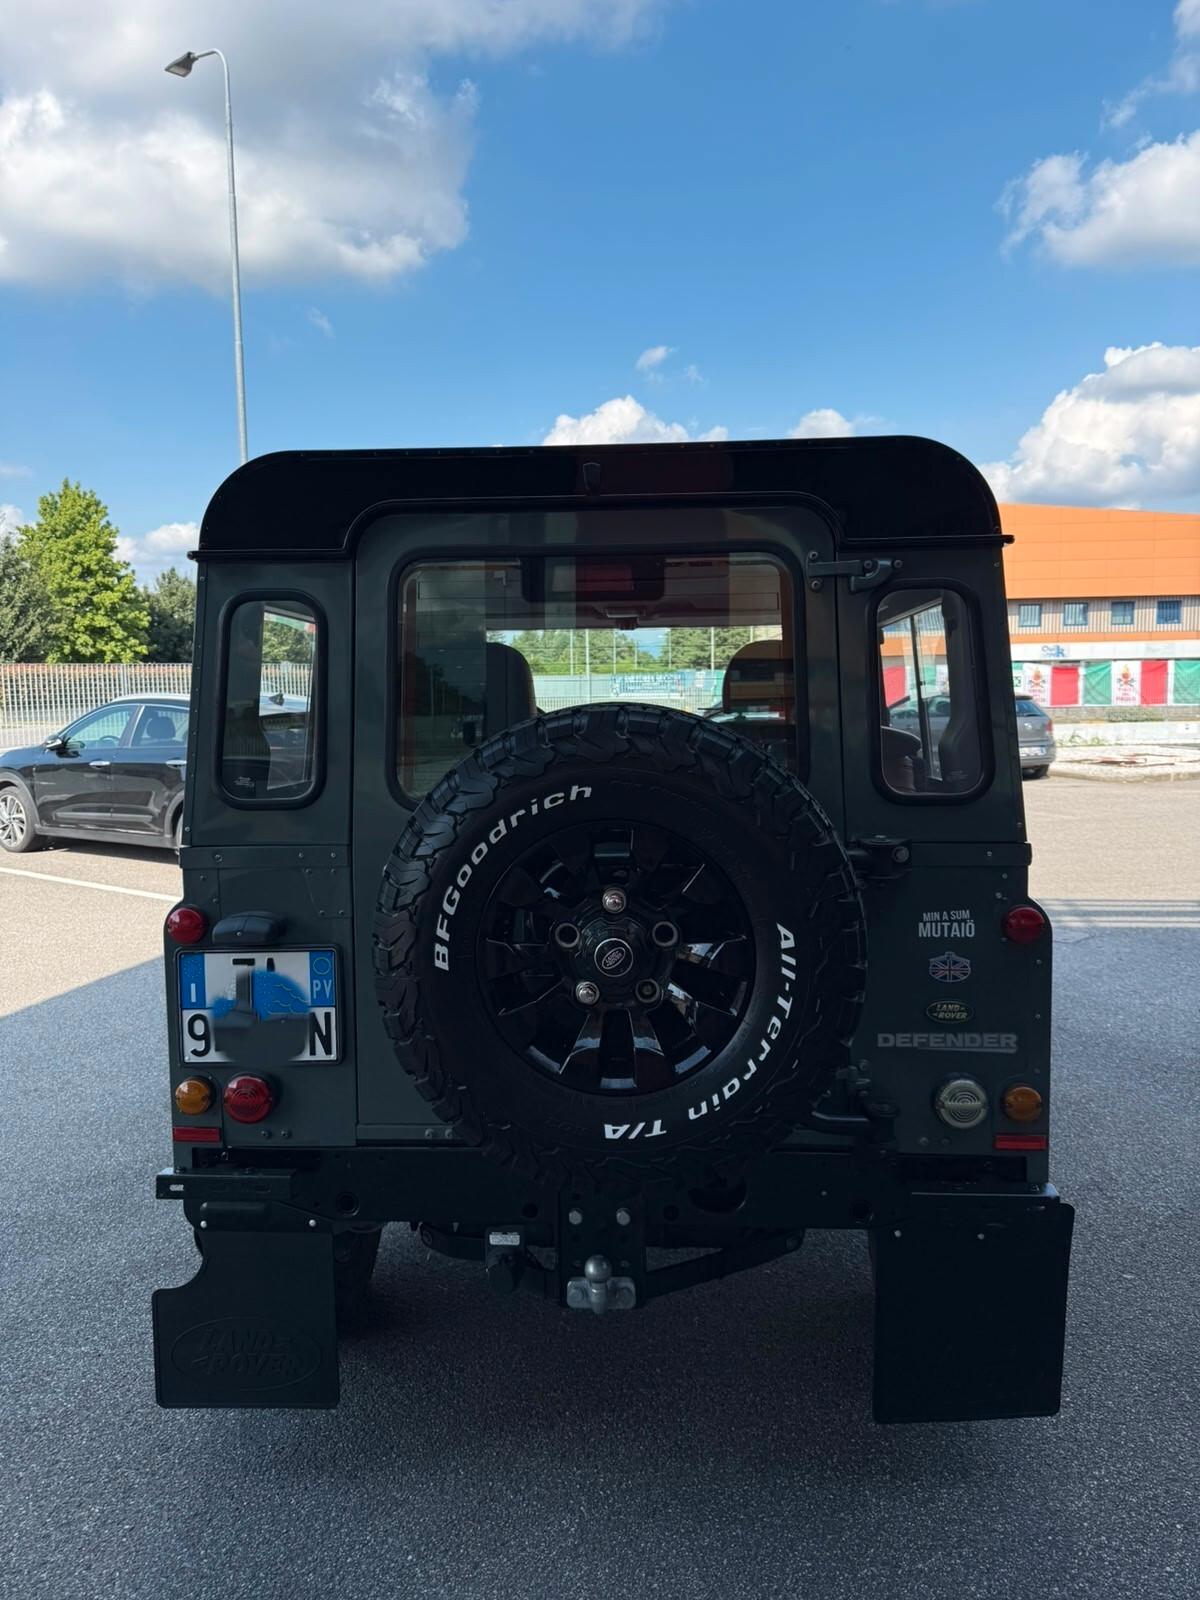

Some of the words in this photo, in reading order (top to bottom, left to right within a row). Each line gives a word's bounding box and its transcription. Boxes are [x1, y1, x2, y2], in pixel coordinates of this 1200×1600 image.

[434, 785, 593, 972] BFGoodrich
[922, 912, 941, 922] MIN
[942, 910, 949, 921] A
[950, 909, 970, 920] SUM
[312, 979, 333, 999] PV
[687, 922, 797, 1121] All-Terrain
[877, 1033, 1019, 1049] DEFENDER
[603, 1118, 668, 1140] T/A
